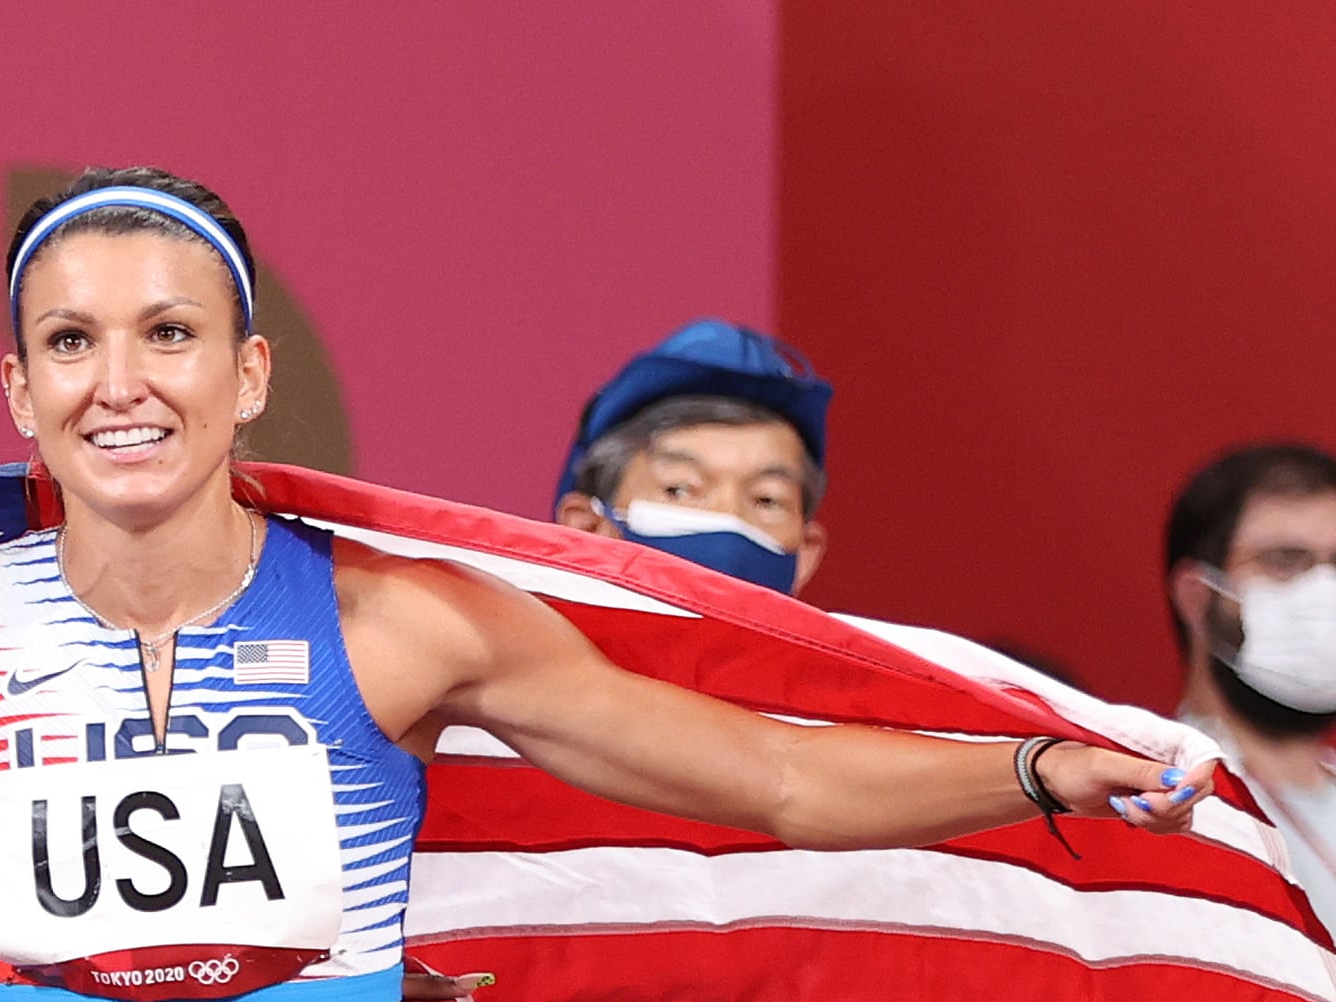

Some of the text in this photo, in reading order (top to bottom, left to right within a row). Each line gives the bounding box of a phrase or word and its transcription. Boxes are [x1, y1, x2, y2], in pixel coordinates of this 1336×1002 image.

[31, 783, 286, 918] USA
[90, 966, 185, 987] TOKYO 2020
